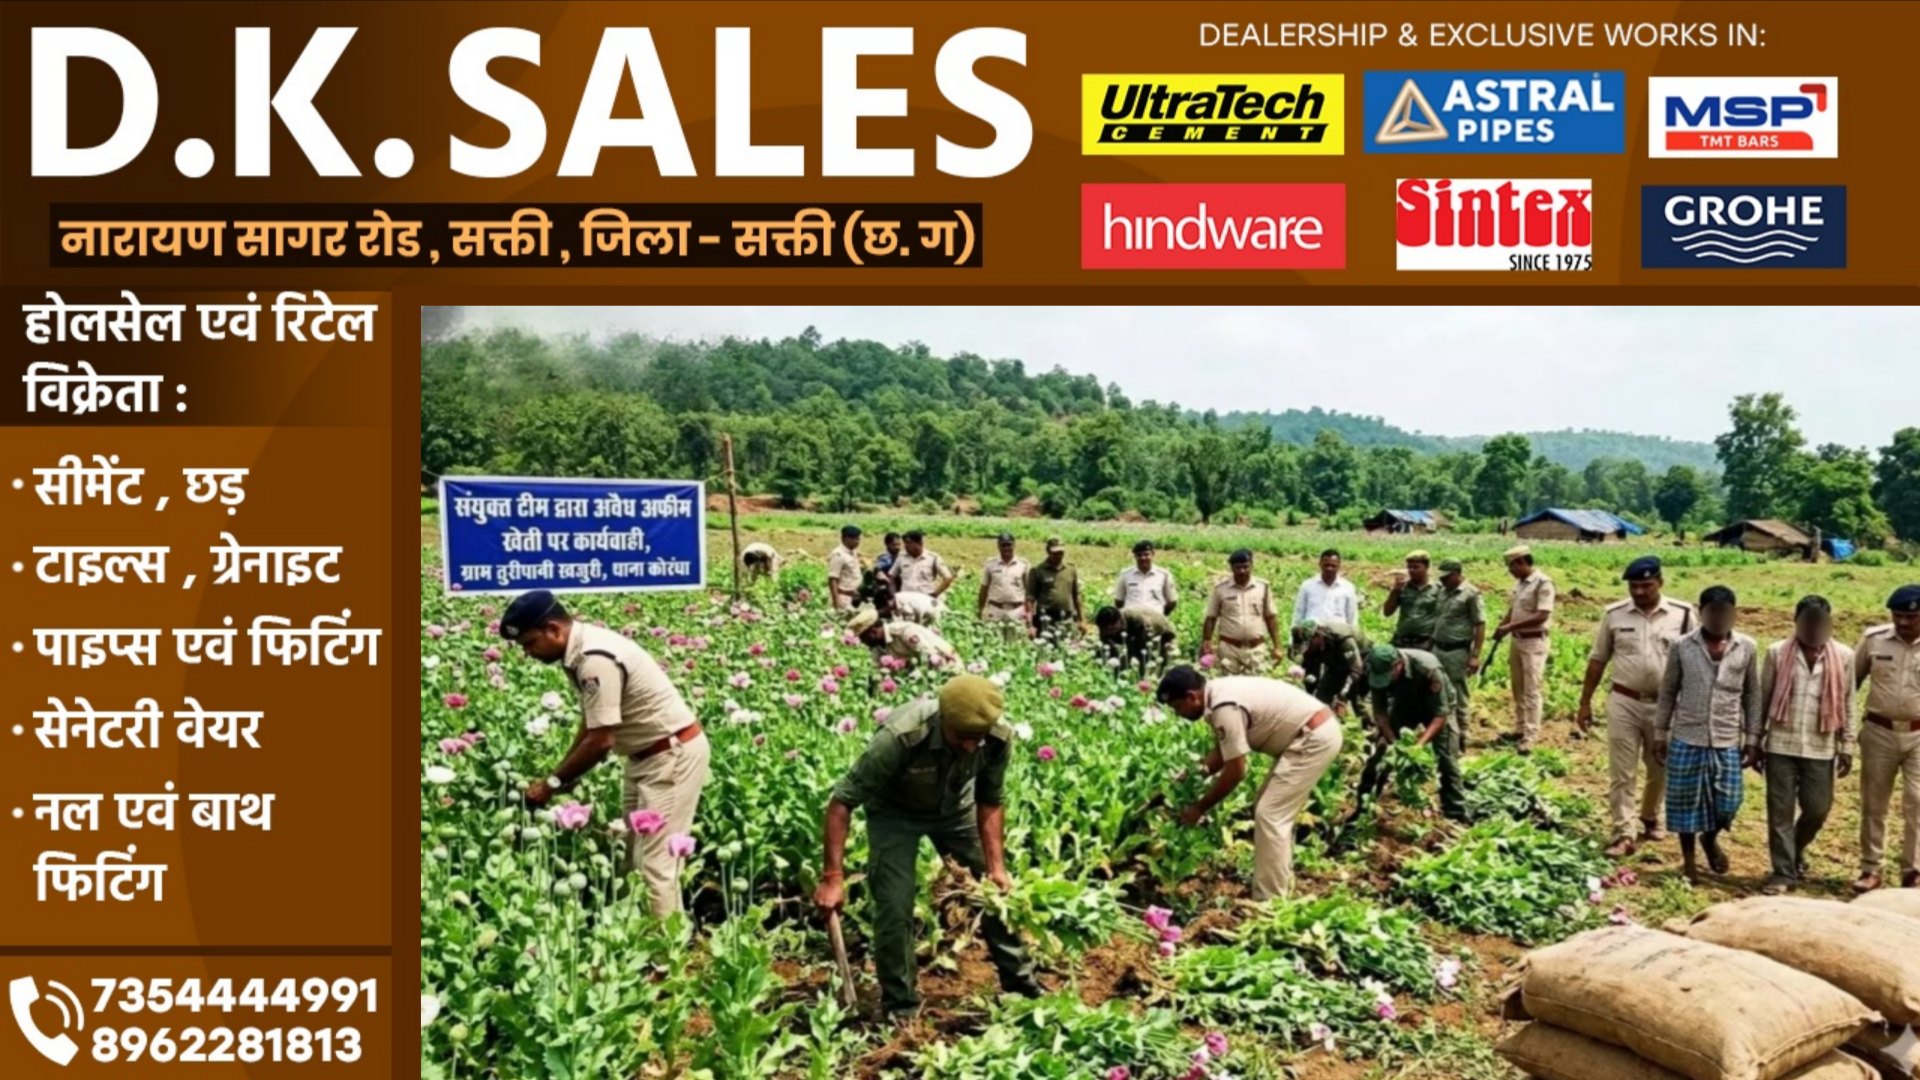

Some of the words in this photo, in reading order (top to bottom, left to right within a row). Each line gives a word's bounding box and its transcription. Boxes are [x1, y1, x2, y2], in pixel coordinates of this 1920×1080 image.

[454, 491, 512, 524] संयुक्त
[517, 492, 549, 518] टीम
[554, 496, 588, 518] द्वारा
[593, 492, 636, 518] अवैध
[641, 494, 692, 518] अफीम
[502, 526, 543, 552] खेती
[547, 531, 569, 551] पर
[573, 525, 652, 554] कार्यवाही,
[460, 564, 493, 582] ग्राम
